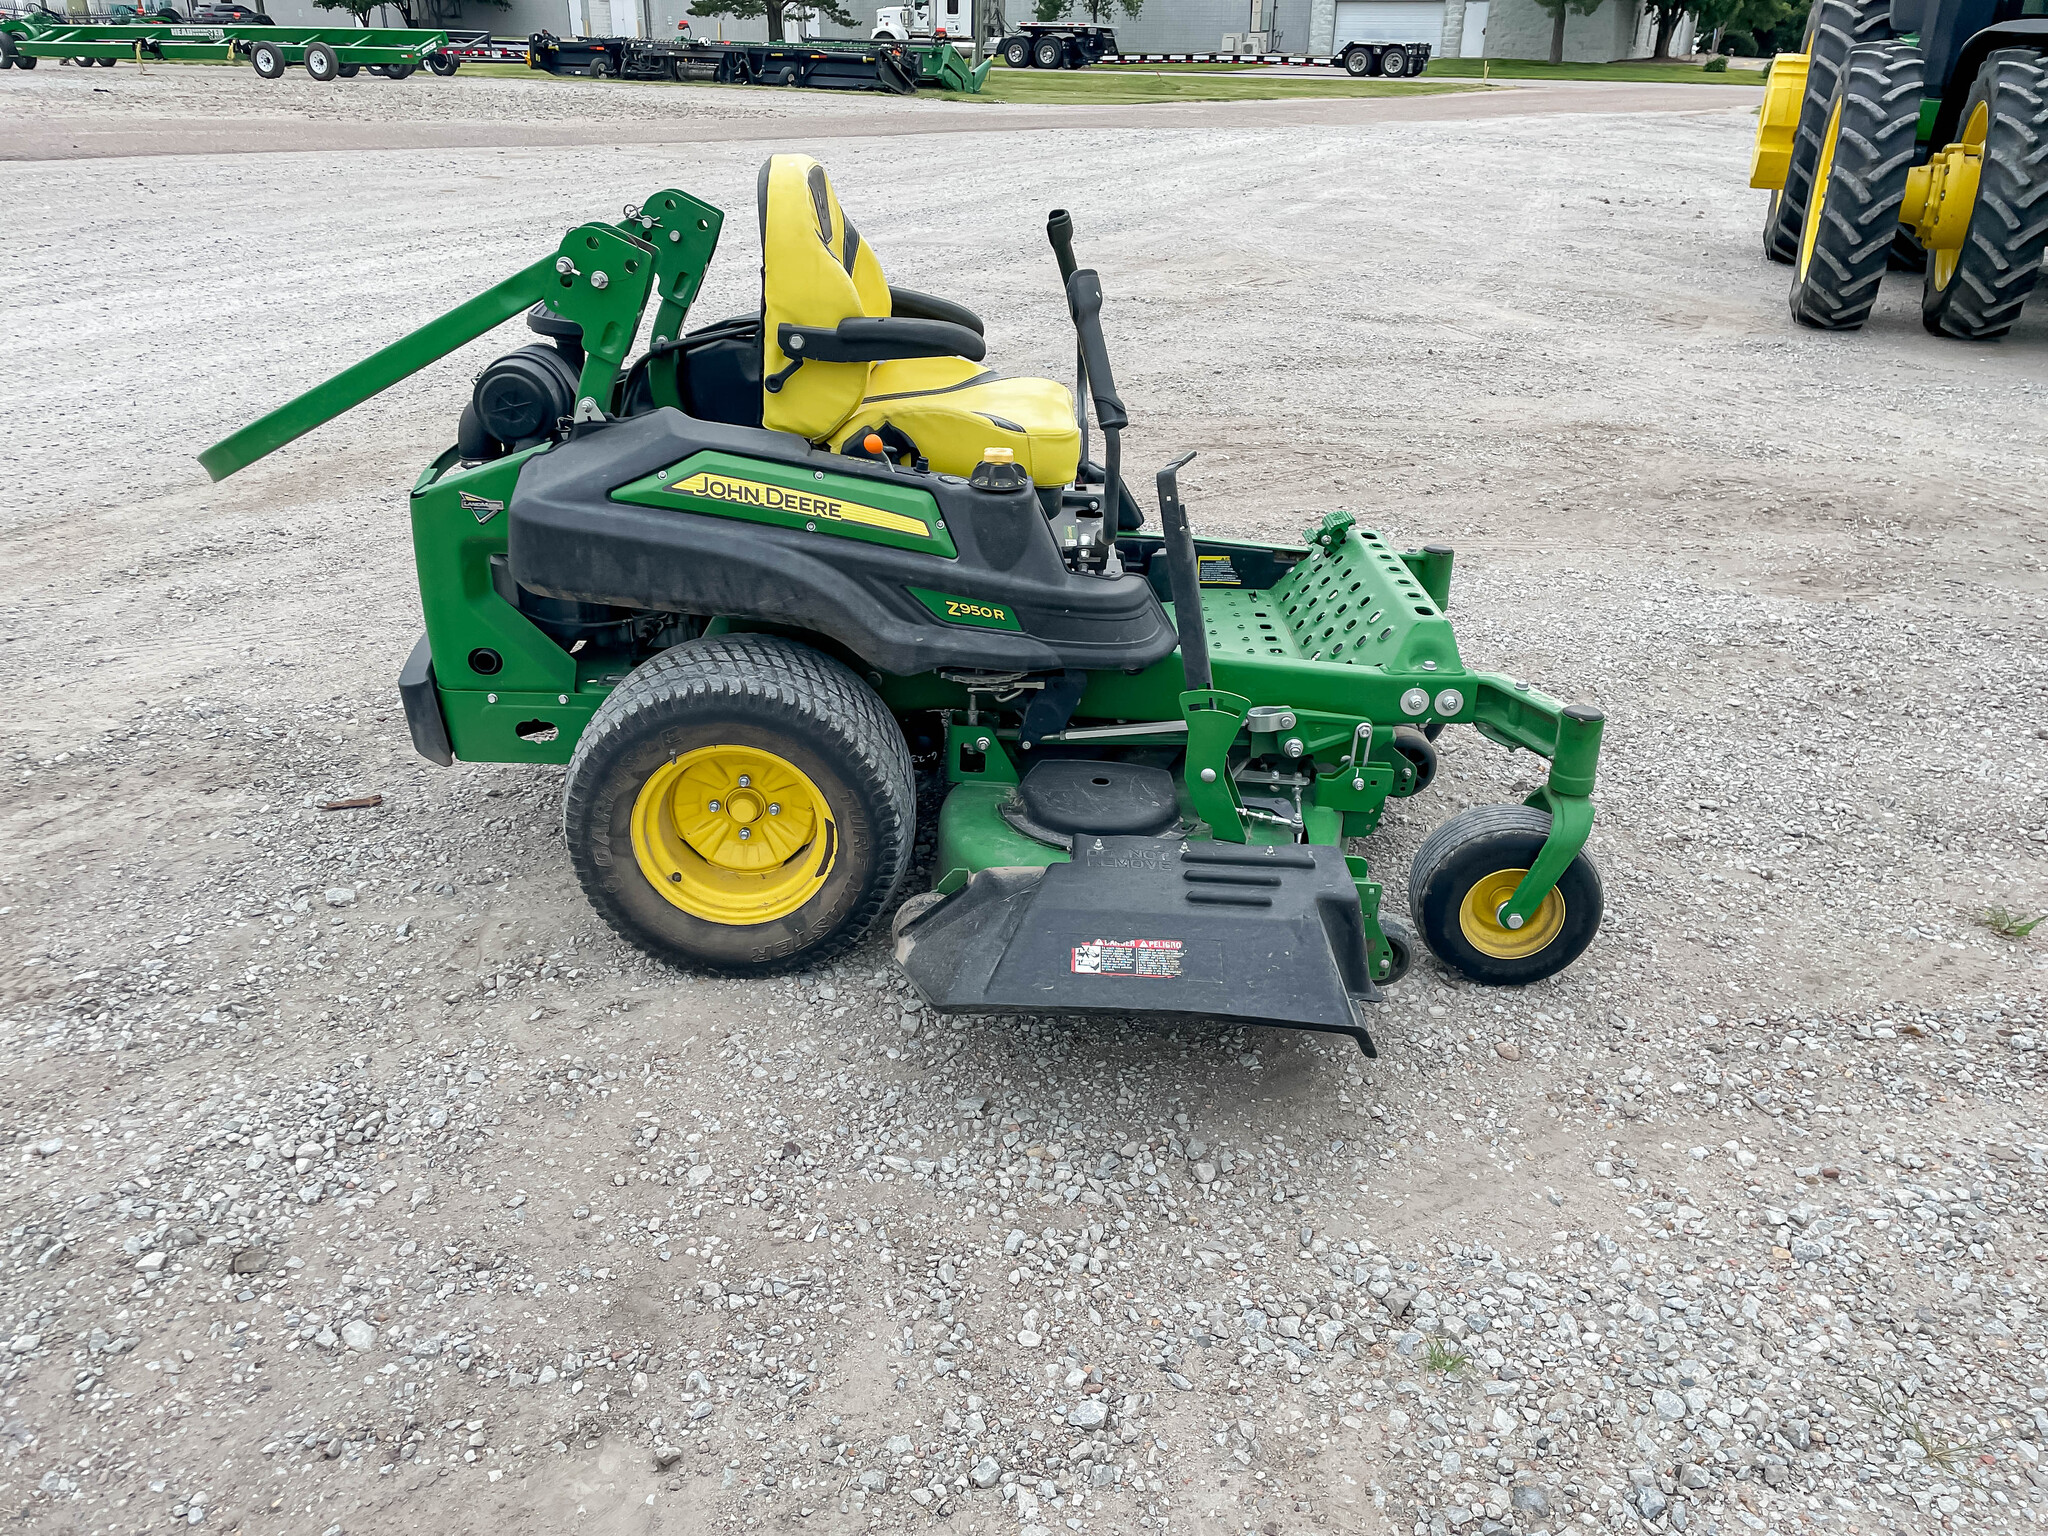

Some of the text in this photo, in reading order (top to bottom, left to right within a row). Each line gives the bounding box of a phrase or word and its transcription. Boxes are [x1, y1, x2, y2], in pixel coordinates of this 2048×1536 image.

[696, 477, 842, 519] JOHN DEERE
[945, 600, 1006, 621] Z950R
[1128, 847, 1170, 861] NOT
[1086, 857, 1172, 871] REMOVE
[751, 789, 870, 963] TURF MASTER
[1148, 940, 1182, 949] PELIGRO
